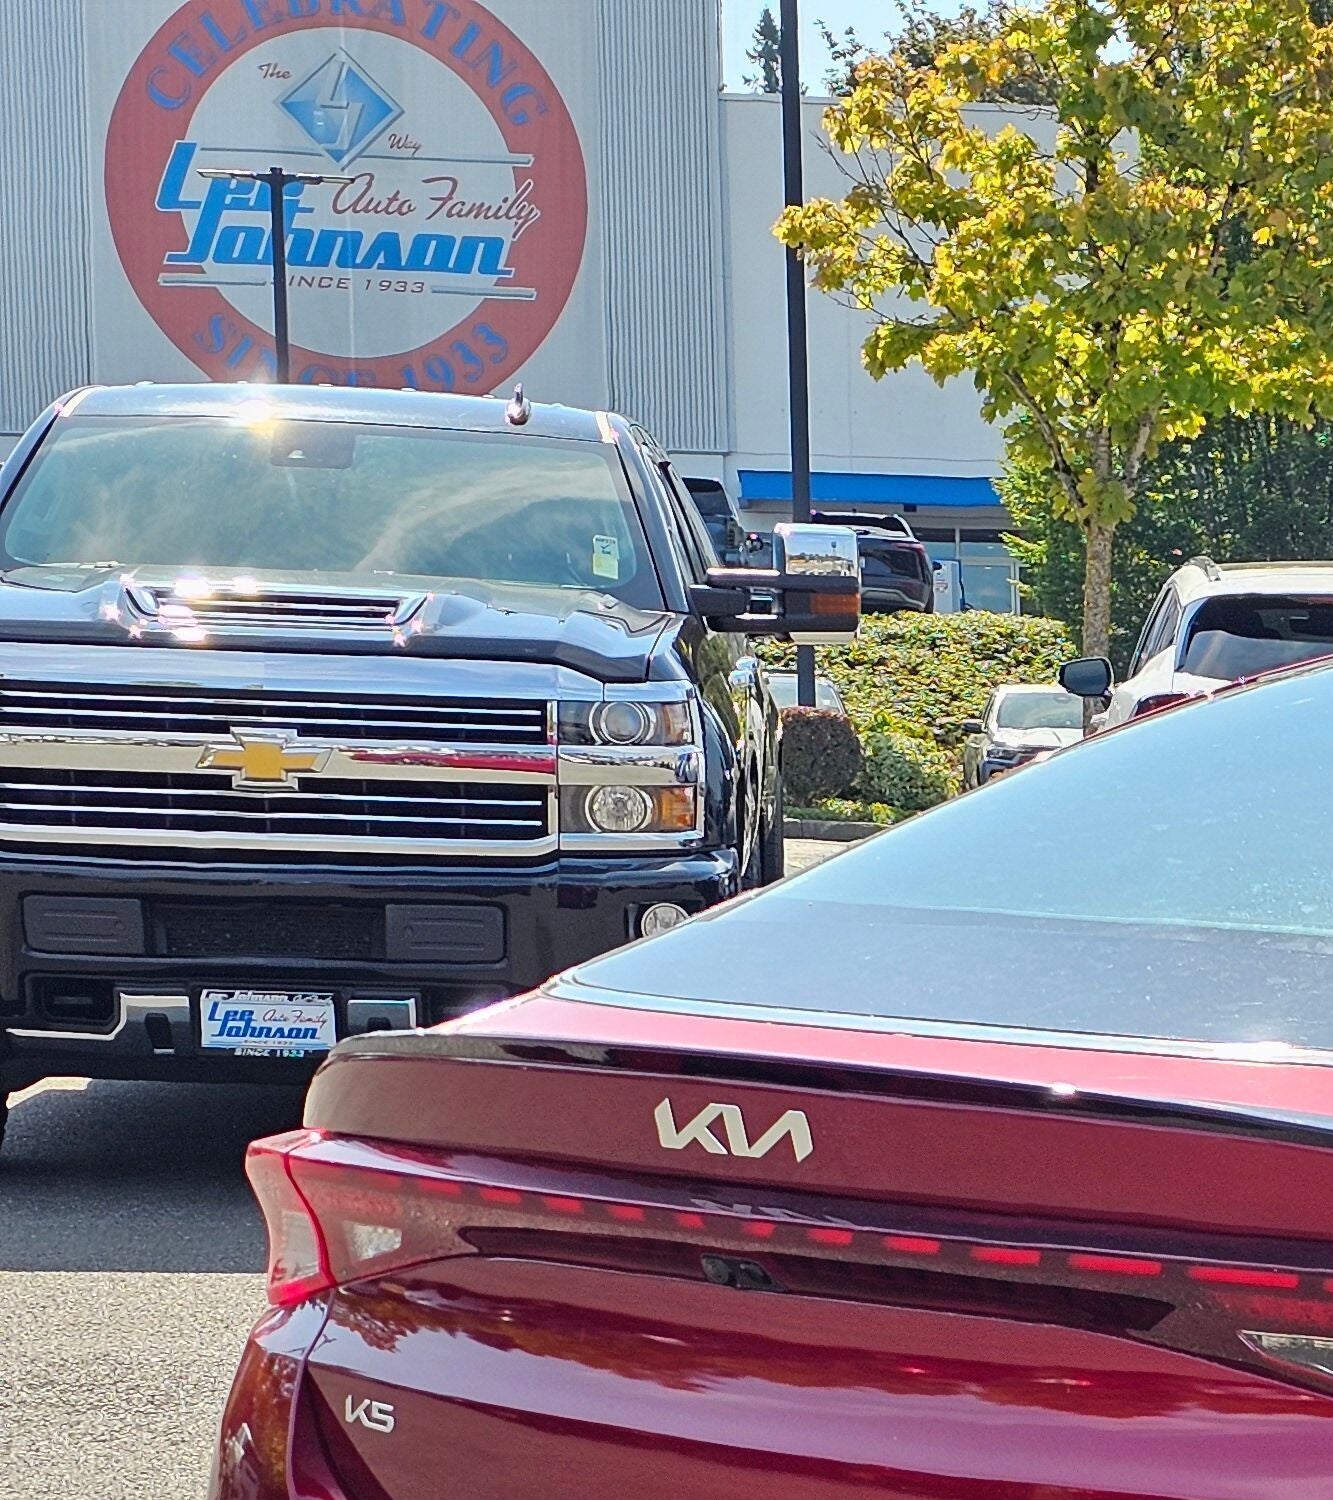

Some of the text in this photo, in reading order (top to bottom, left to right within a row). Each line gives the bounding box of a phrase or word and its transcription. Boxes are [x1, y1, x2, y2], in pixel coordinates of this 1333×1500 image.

[258, 62, 292, 80] The
[388, 133, 422, 156] Way
[332, 172, 416, 216] Auto
[422, 175, 541, 240] Family
[165, 190, 515, 277] Johnson
[363, 278, 425, 294] 1933
[207, 1001, 258, 1022] Lee
[211, 1016, 321, 1040] Johnson
[654, 1097, 814, 1163] KIA
[345, 1394, 395, 1434] K5
